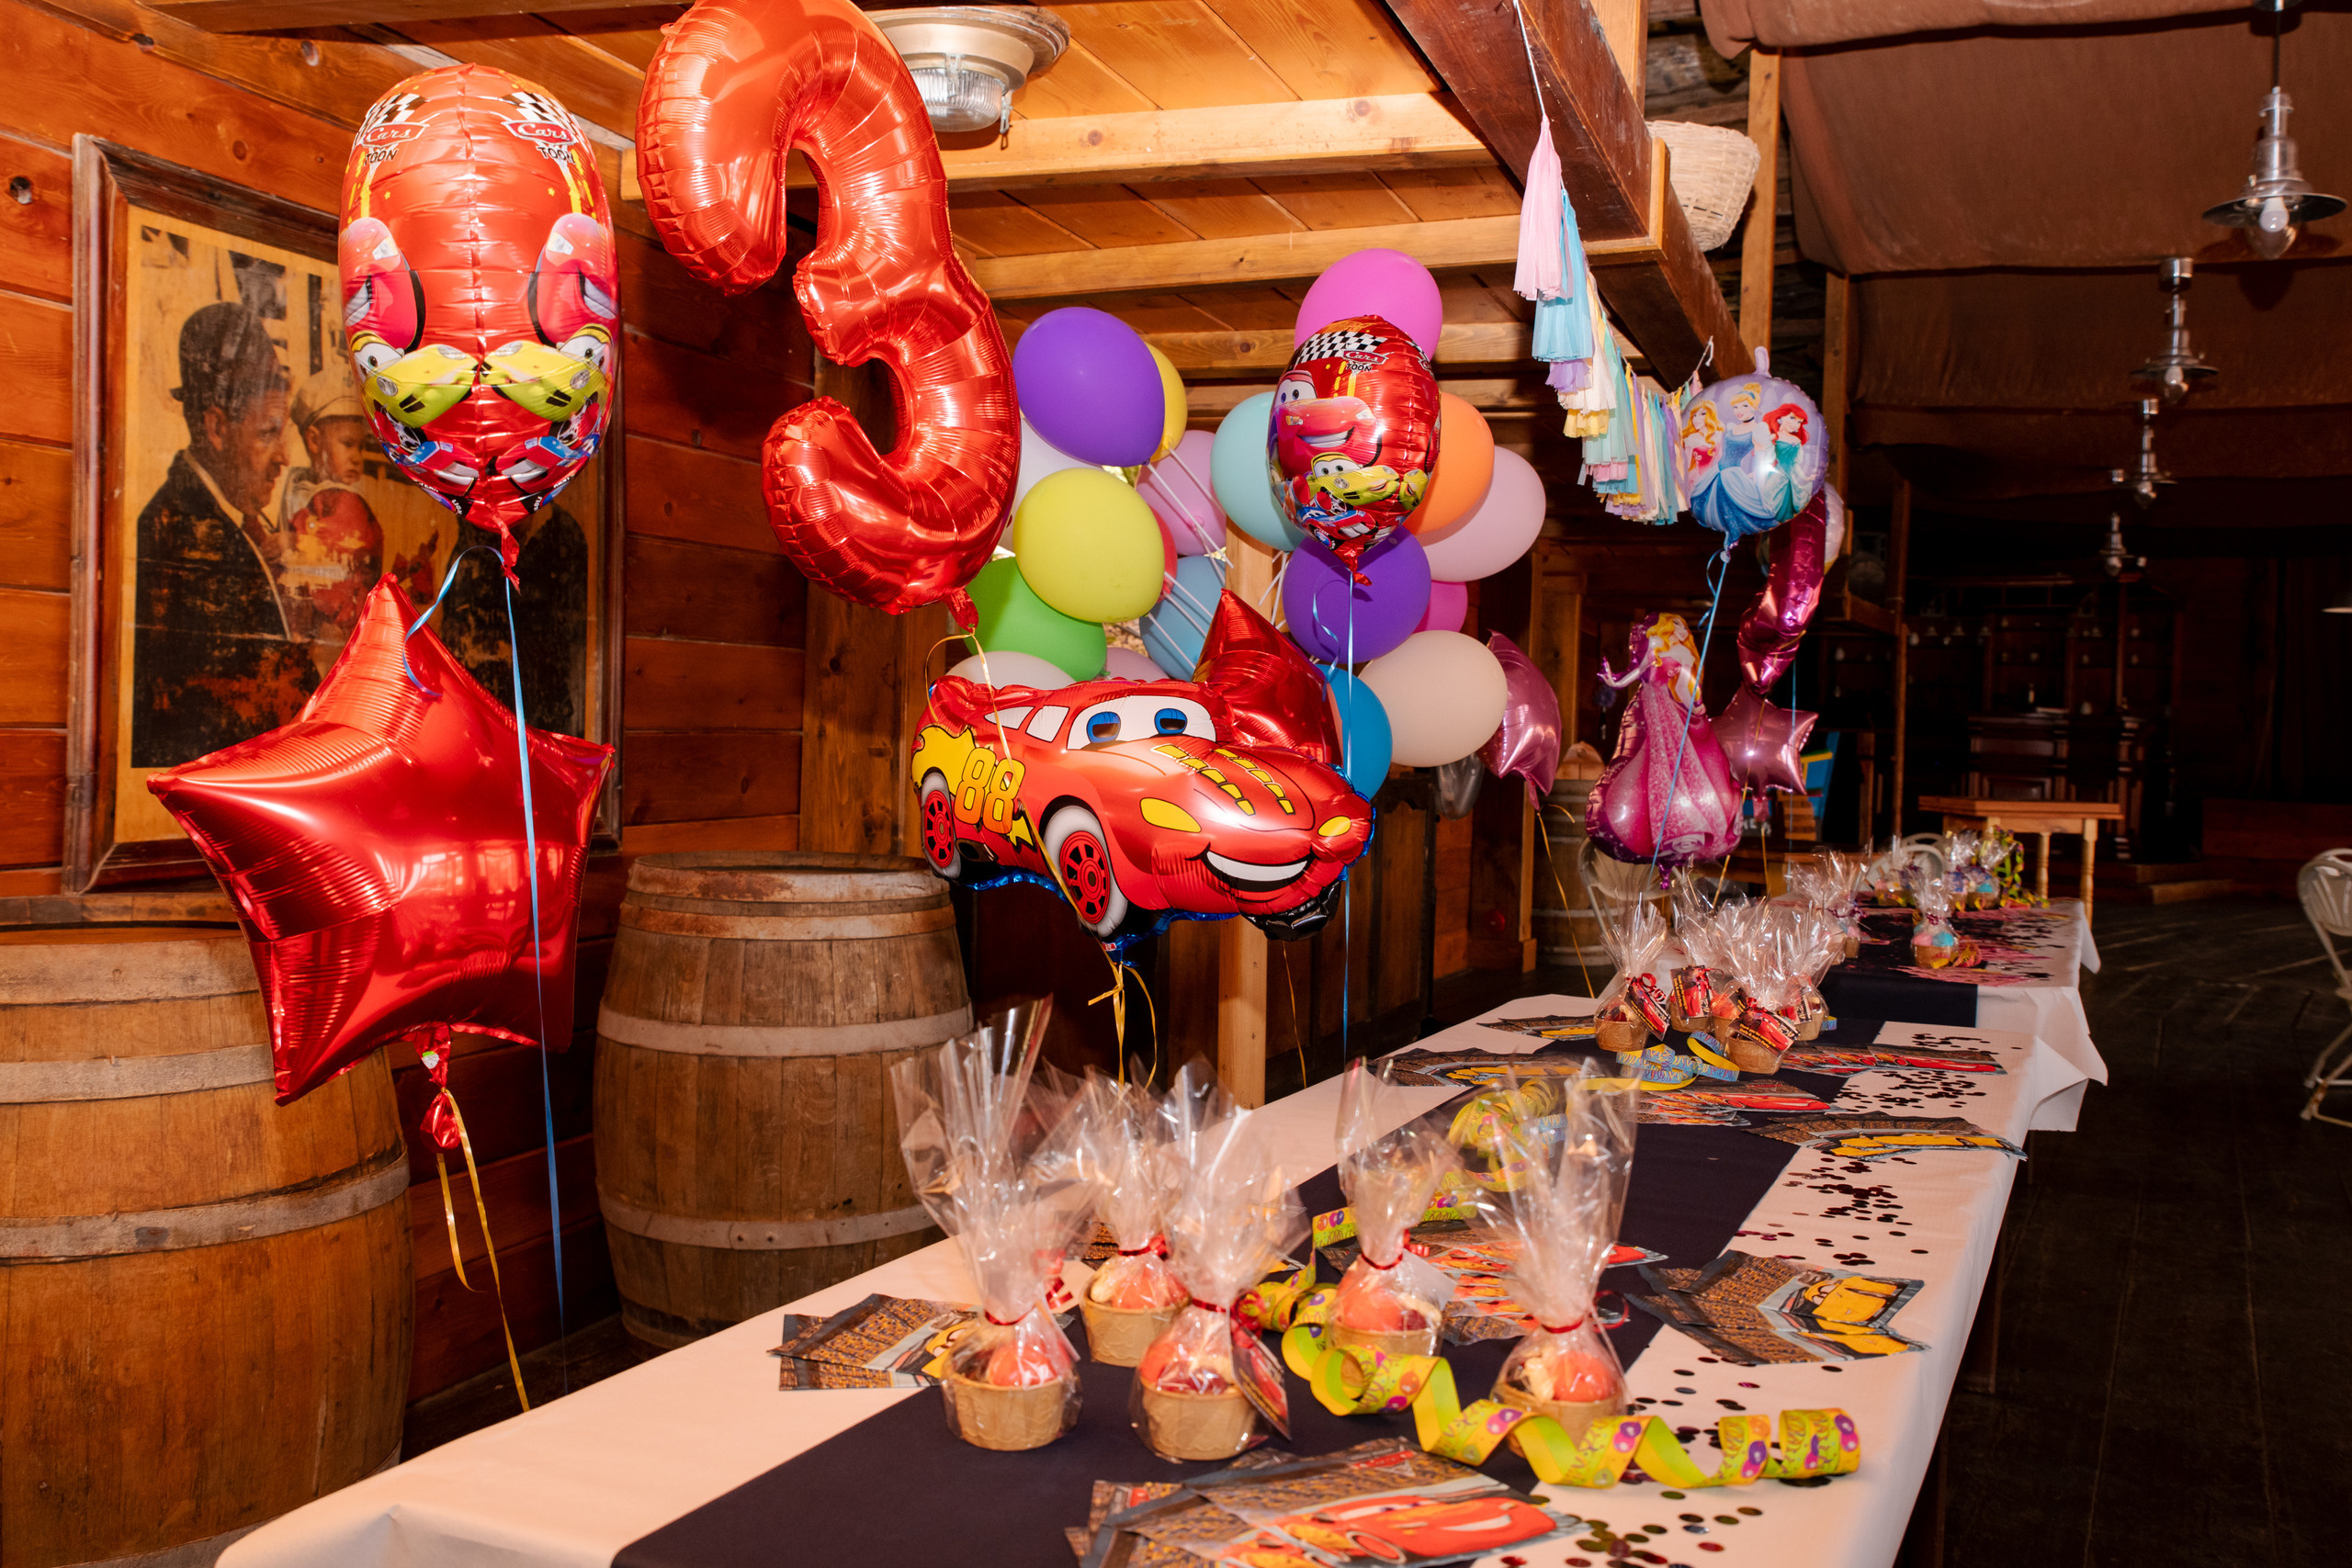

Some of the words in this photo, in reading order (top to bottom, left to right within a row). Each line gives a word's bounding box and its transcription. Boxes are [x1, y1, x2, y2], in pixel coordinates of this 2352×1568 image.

[366, 127, 412, 142] Cars
[517, 123, 571, 141] Cars
[364, 149, 399, 166] TOON
[536, 145, 577, 164] TOON
[1345, 351, 1379, 362] Cars
[1346, 362, 1373, 372] TOON
[954, 746, 1026, 835] 88
